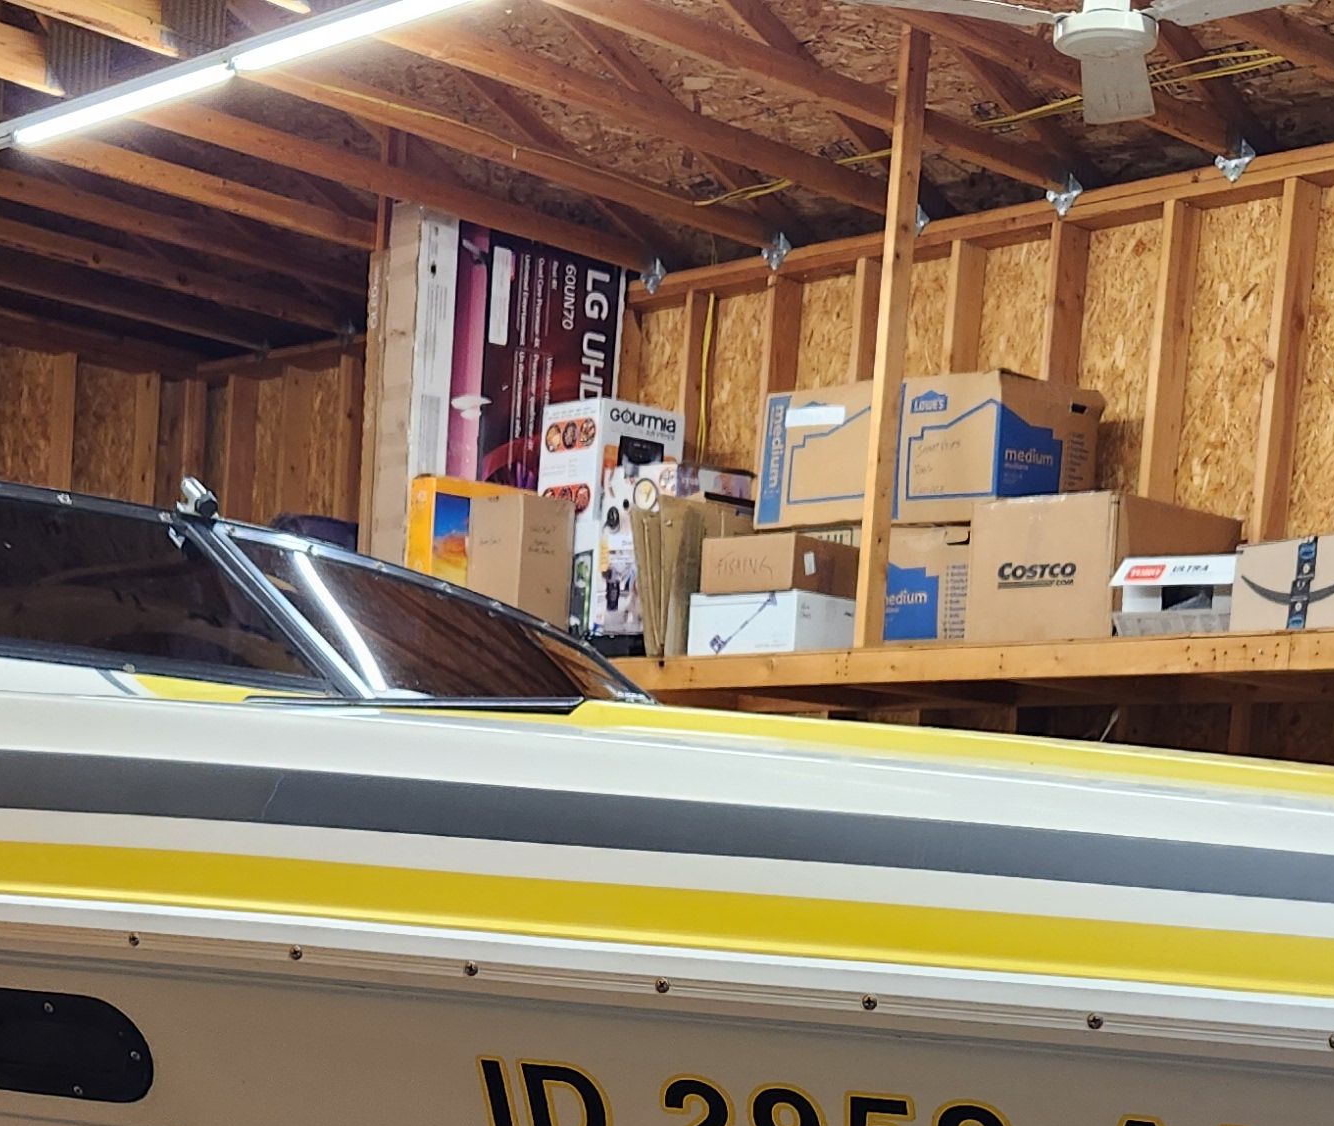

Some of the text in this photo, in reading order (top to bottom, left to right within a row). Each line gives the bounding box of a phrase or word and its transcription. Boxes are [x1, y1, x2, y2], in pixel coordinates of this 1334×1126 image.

[562, 264, 576, 330] 60UN70
[585, 269, 610, 321] LG
[769, 404, 785, 488] medium
[1004, 448, 1053, 466] medium
[998, 562, 1076, 580] COSTCO
